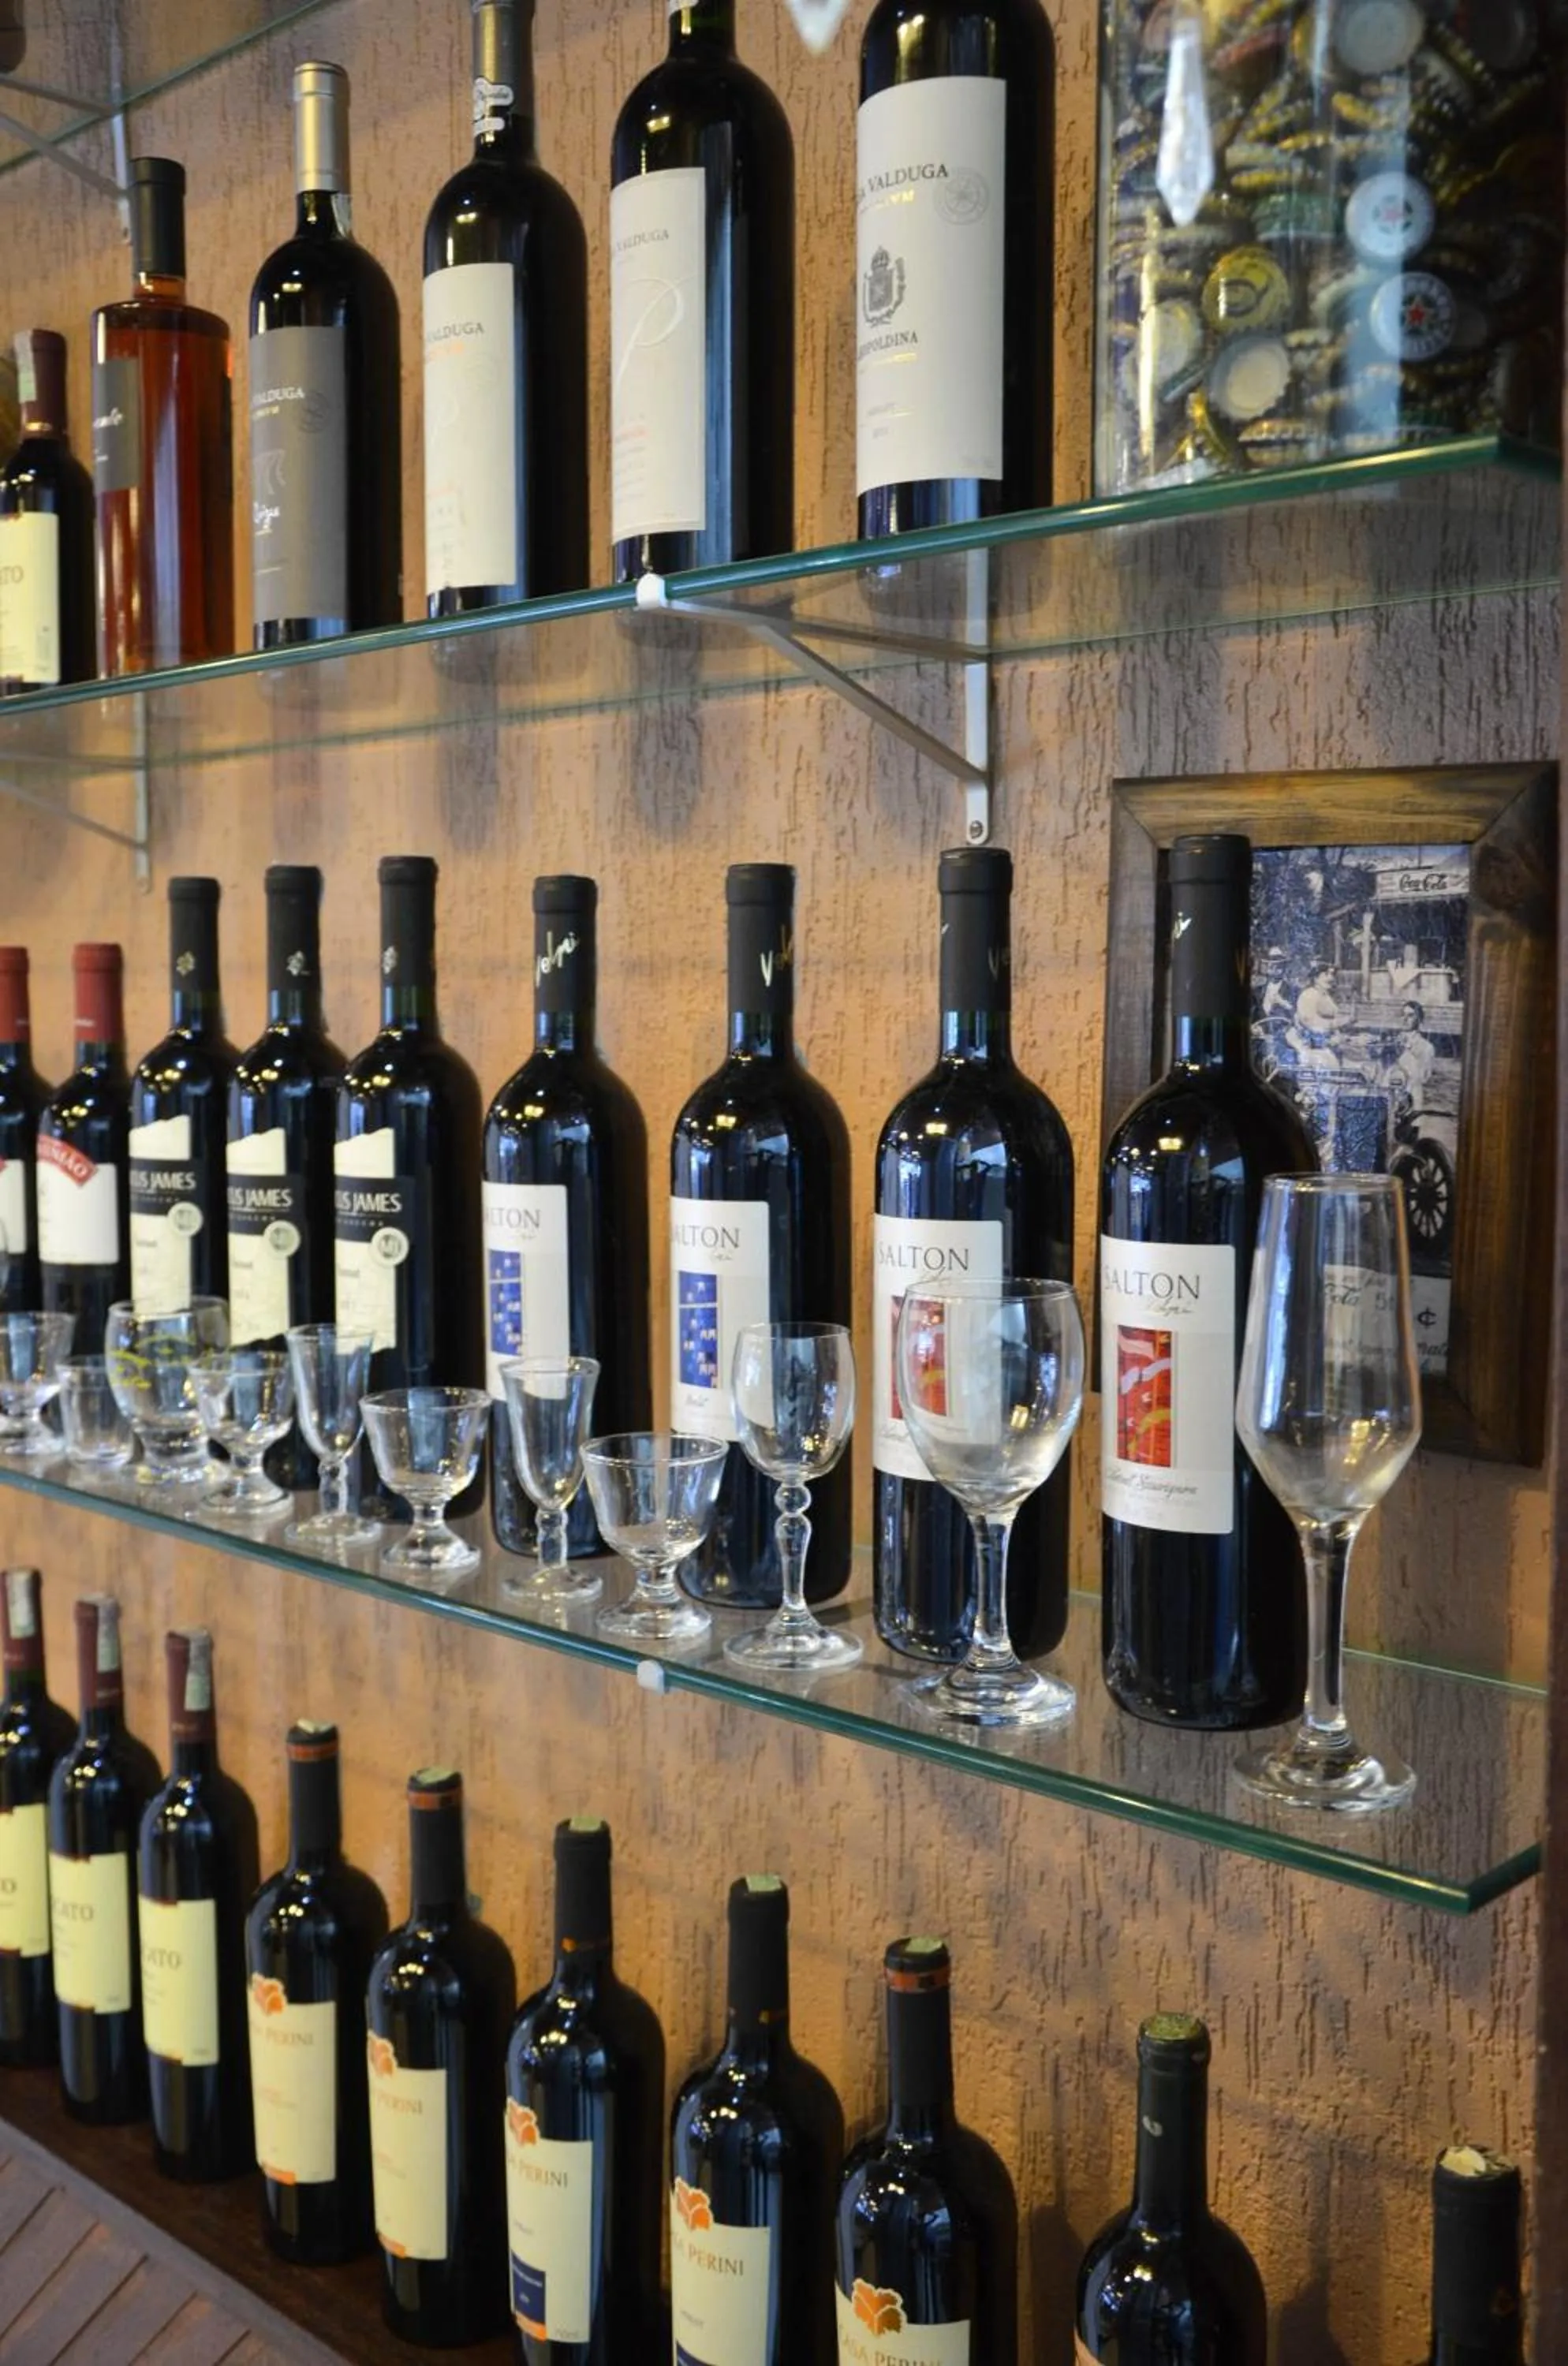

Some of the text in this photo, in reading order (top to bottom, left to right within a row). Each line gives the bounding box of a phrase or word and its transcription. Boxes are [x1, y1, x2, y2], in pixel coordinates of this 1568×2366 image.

[868, 163, 949, 192] VALDUGA
[857, 330, 919, 362] POLDINA
[150, 1170, 197, 1194] JAMES
[245, 1188, 293, 1209] JAMES
[353, 1192, 403, 1213] JAMES
[485, 1207, 542, 1230] LTON
[877, 1241, 969, 1271] SALTON
[518, 2159, 568, 2189] PERINI
[688, 2243, 745, 2277] PERINI
